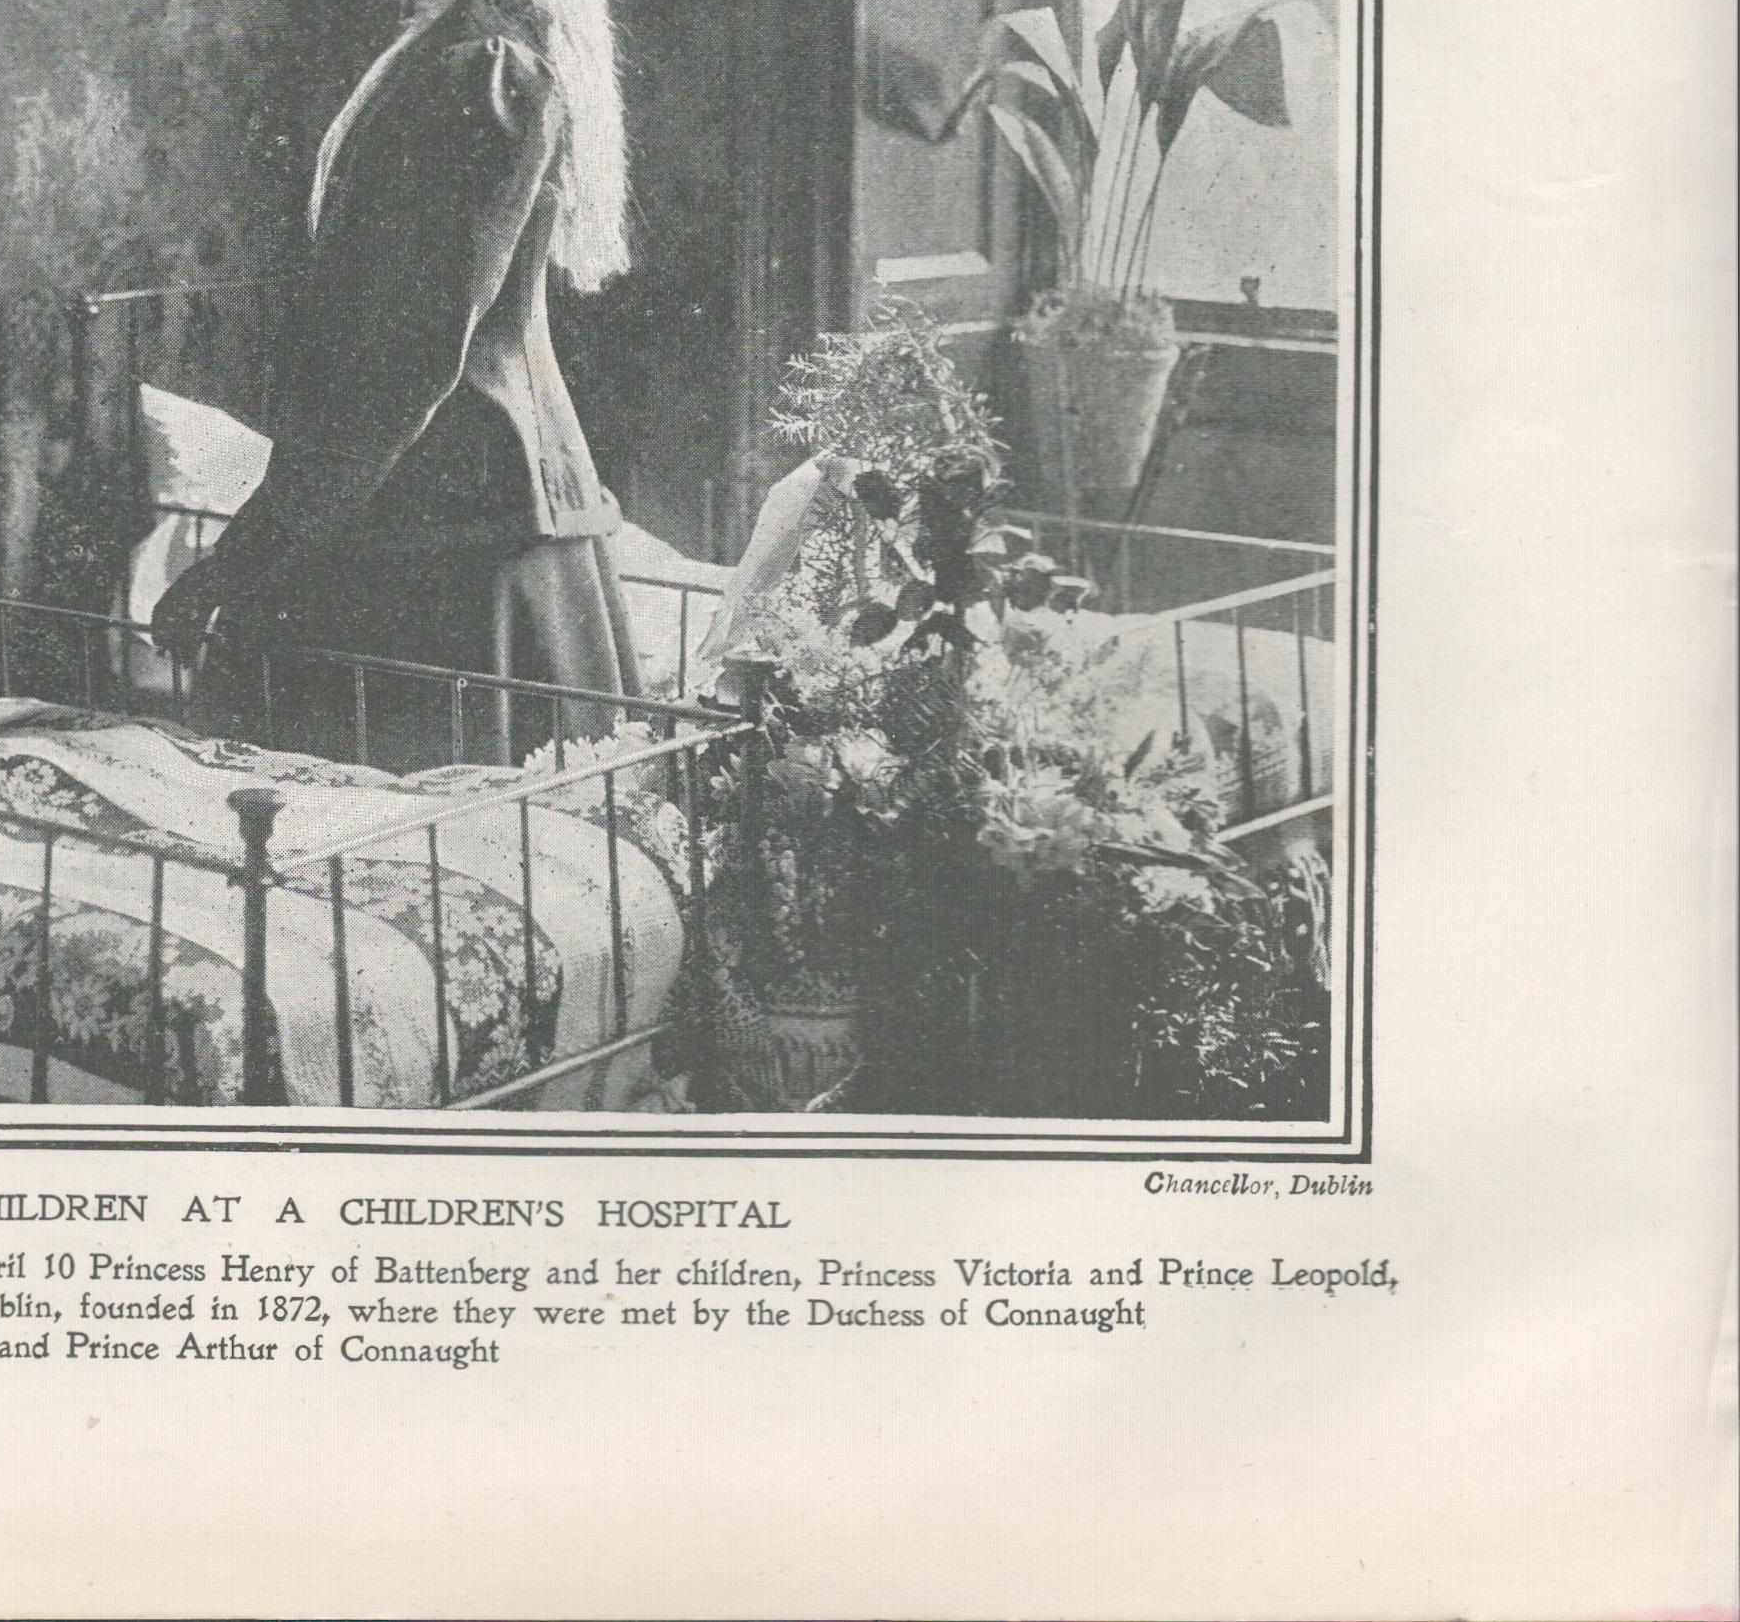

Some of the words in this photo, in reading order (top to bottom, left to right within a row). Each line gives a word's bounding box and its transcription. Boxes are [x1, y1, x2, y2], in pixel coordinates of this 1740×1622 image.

[1143, 1170, 1281, 1200] Chancellor,
[1289, 1174, 1373, 1196] Dublin
[181, 1195, 242, 1223] AT
[275, 1197, 305, 1224] A
[339, 1198, 564, 1228] CHILDREN'S
[598, 1200, 791, 1229] HOSPITAL
[45, 1253, 75, 1280] 10
[89, 1253, 206, 1282] Princess
[221, 1254, 315, 1288] Henry
[331, 1255, 359, 1284] of
[374, 1256, 530, 1292] Battenberg
[546, 1258, 599, 1285] and
[616, 1258, 661, 1285] her
[677, 1258, 801, 1292] children,
[819, 1259, 935, 1287] Princess
[953, 1259, 1072, 1286] Victoria
[1089, 1258, 1143, 1286] and
[1158, 1258, 1253, 1287] Prince
[1271, 1258, 1398, 1294] Leopold,
[80, 1291, 195, 1321] founded
[211, 1295, 239, 1321] in
[258, 1295, 330, 1327] 1872,
[347, 1296, 438, 1324] where
[453, 1297, 516, 1328] they
[533, 1307, 604, 1325] were
[621, 1301, 676, 1325] met
[693, 1298, 730, 1332] by
[746, 1299, 790, 1326] the
[807, 1298, 925, 1327] Duchess
[940, 1298, 968, 1326] of
[985, 1297, 1145, 1333] Connaught
[66, 1331, 160, 1360] Prince
[176, 1331, 278, 1361] Arthur
[294, 1334, 324, 1362] of
[340, 1335, 499, 1370] Connaught
